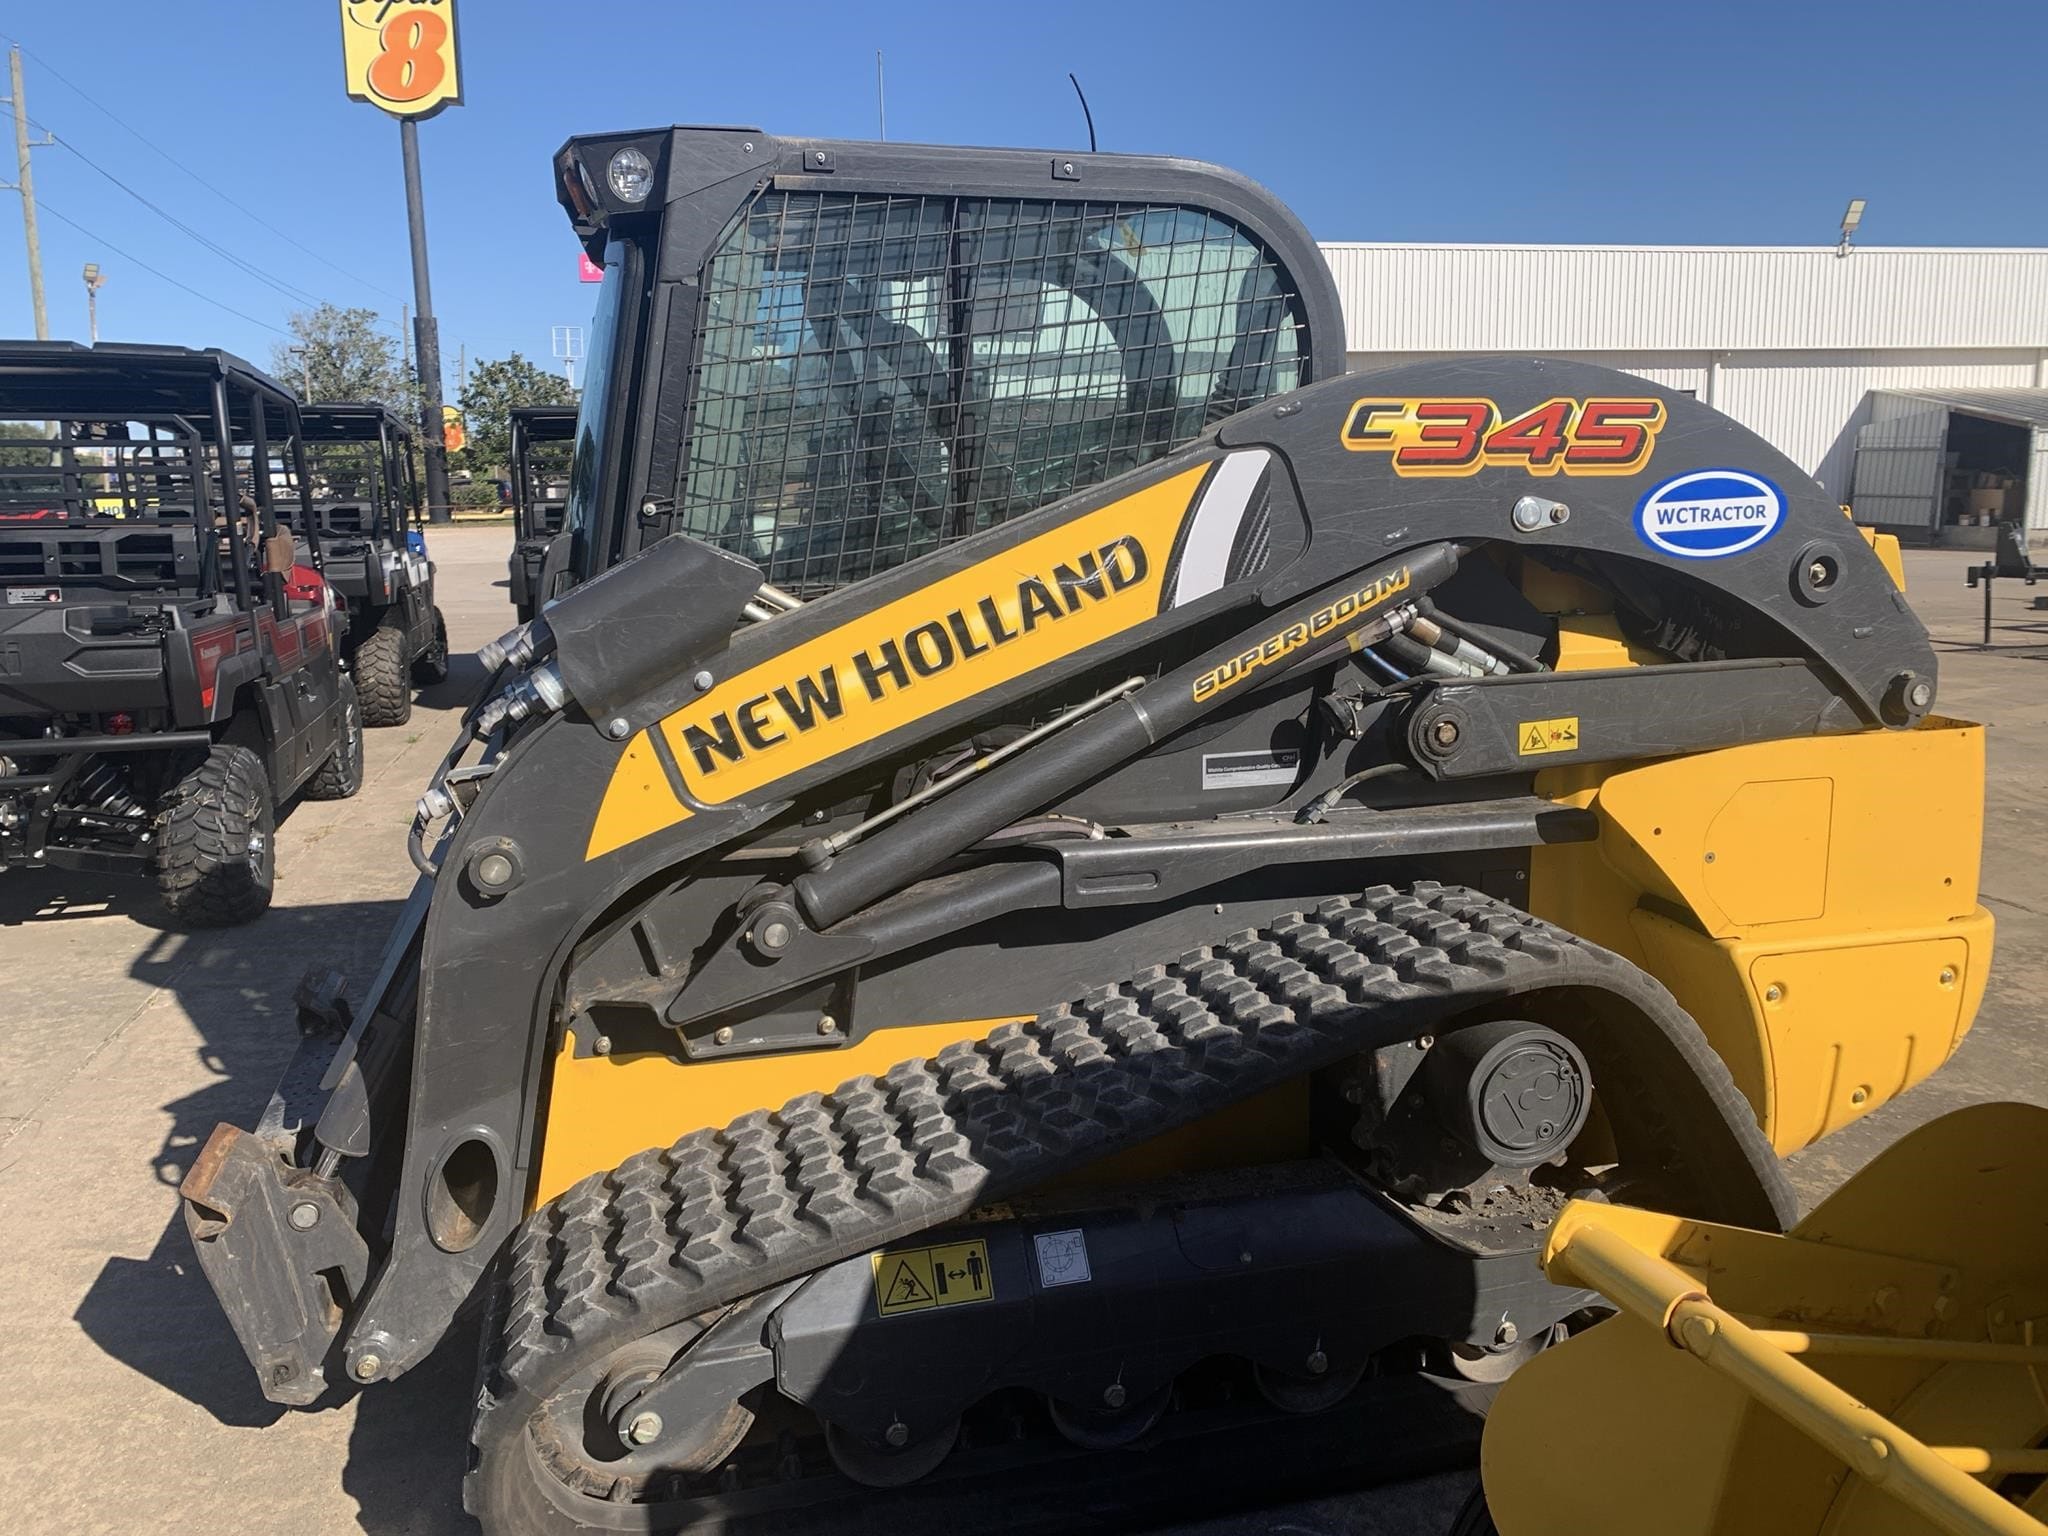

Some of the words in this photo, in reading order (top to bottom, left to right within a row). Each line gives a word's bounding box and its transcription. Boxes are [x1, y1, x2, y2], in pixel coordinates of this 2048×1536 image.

[367, 9, 447, 102] 8
[1656, 503, 1767, 526] WCTRACTOR
[681, 664, 846, 777] NEW
[851, 534, 1150, 702] HOLLAND
[1193, 622, 1308, 703] SUPER
[1310, 565, 1411, 638] BOOM
